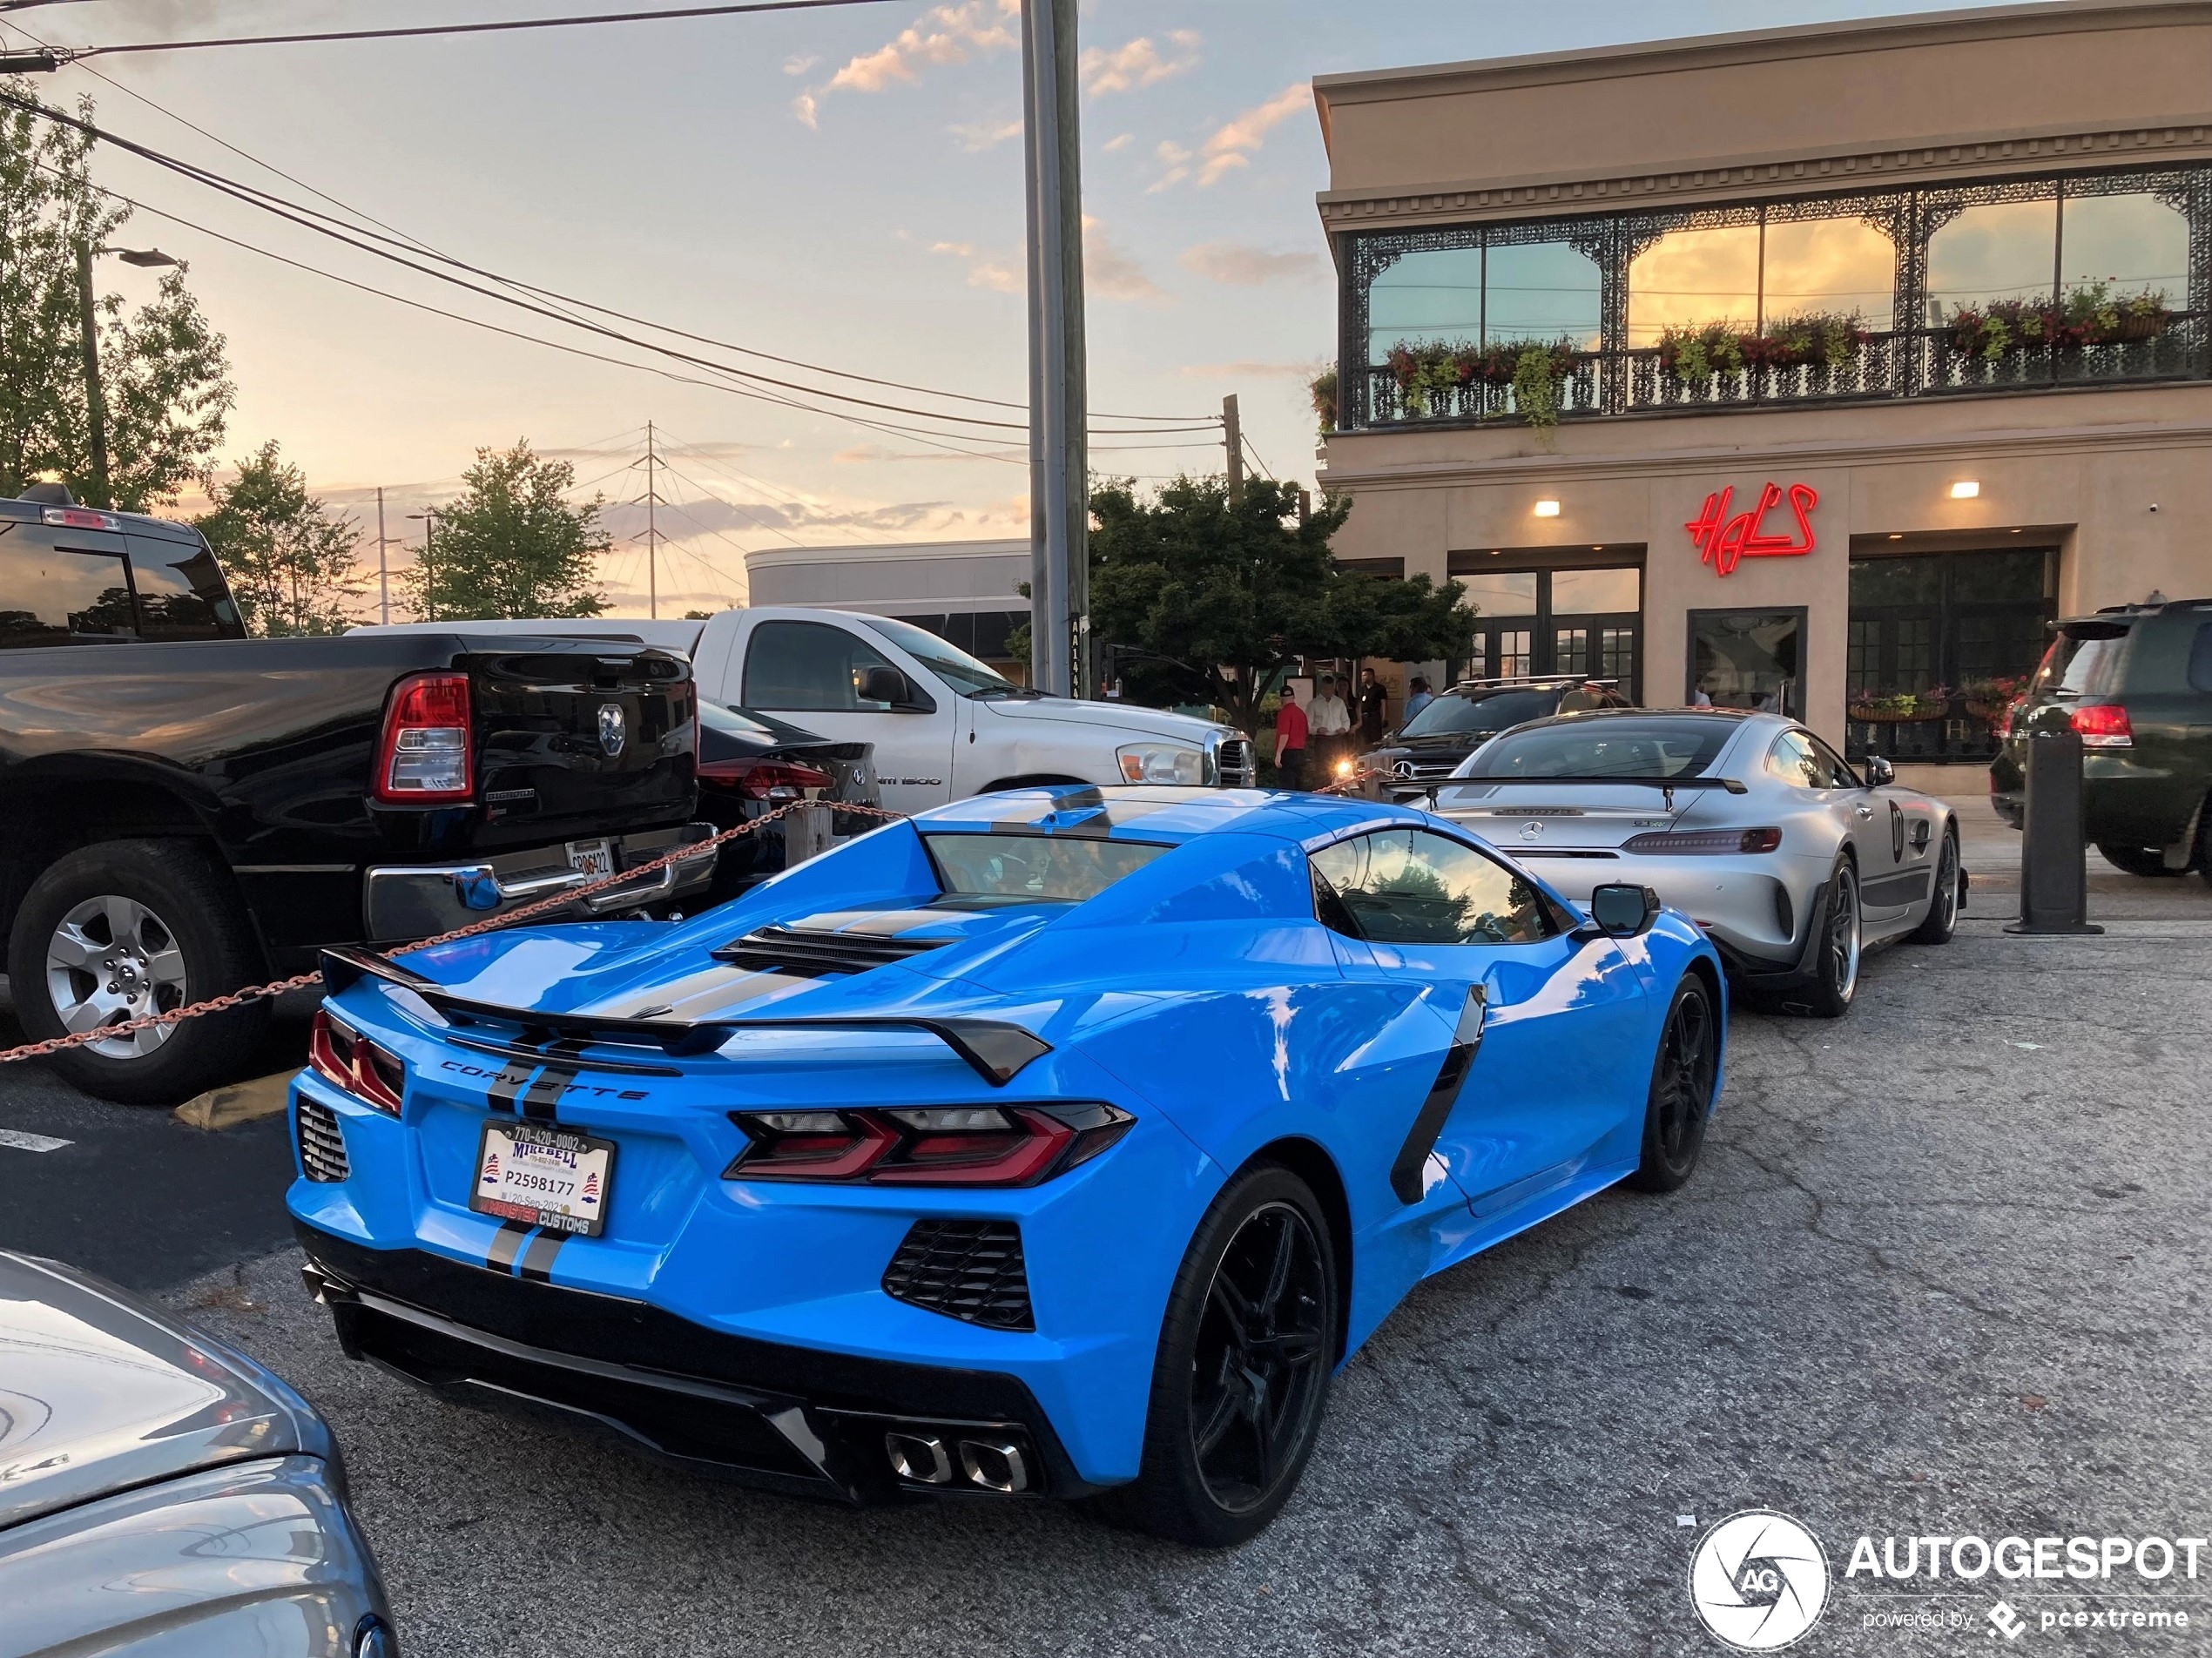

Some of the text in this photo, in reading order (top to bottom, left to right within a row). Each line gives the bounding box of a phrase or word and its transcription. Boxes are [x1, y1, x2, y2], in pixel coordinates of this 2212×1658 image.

[440, 1061, 650, 1100] CORVETTE
[515, 1126, 579, 1151] 770-420-0002
[505, 1170, 575, 1196] P2598177
[488, 1200, 590, 1234] MONSTER CUSTOMS
